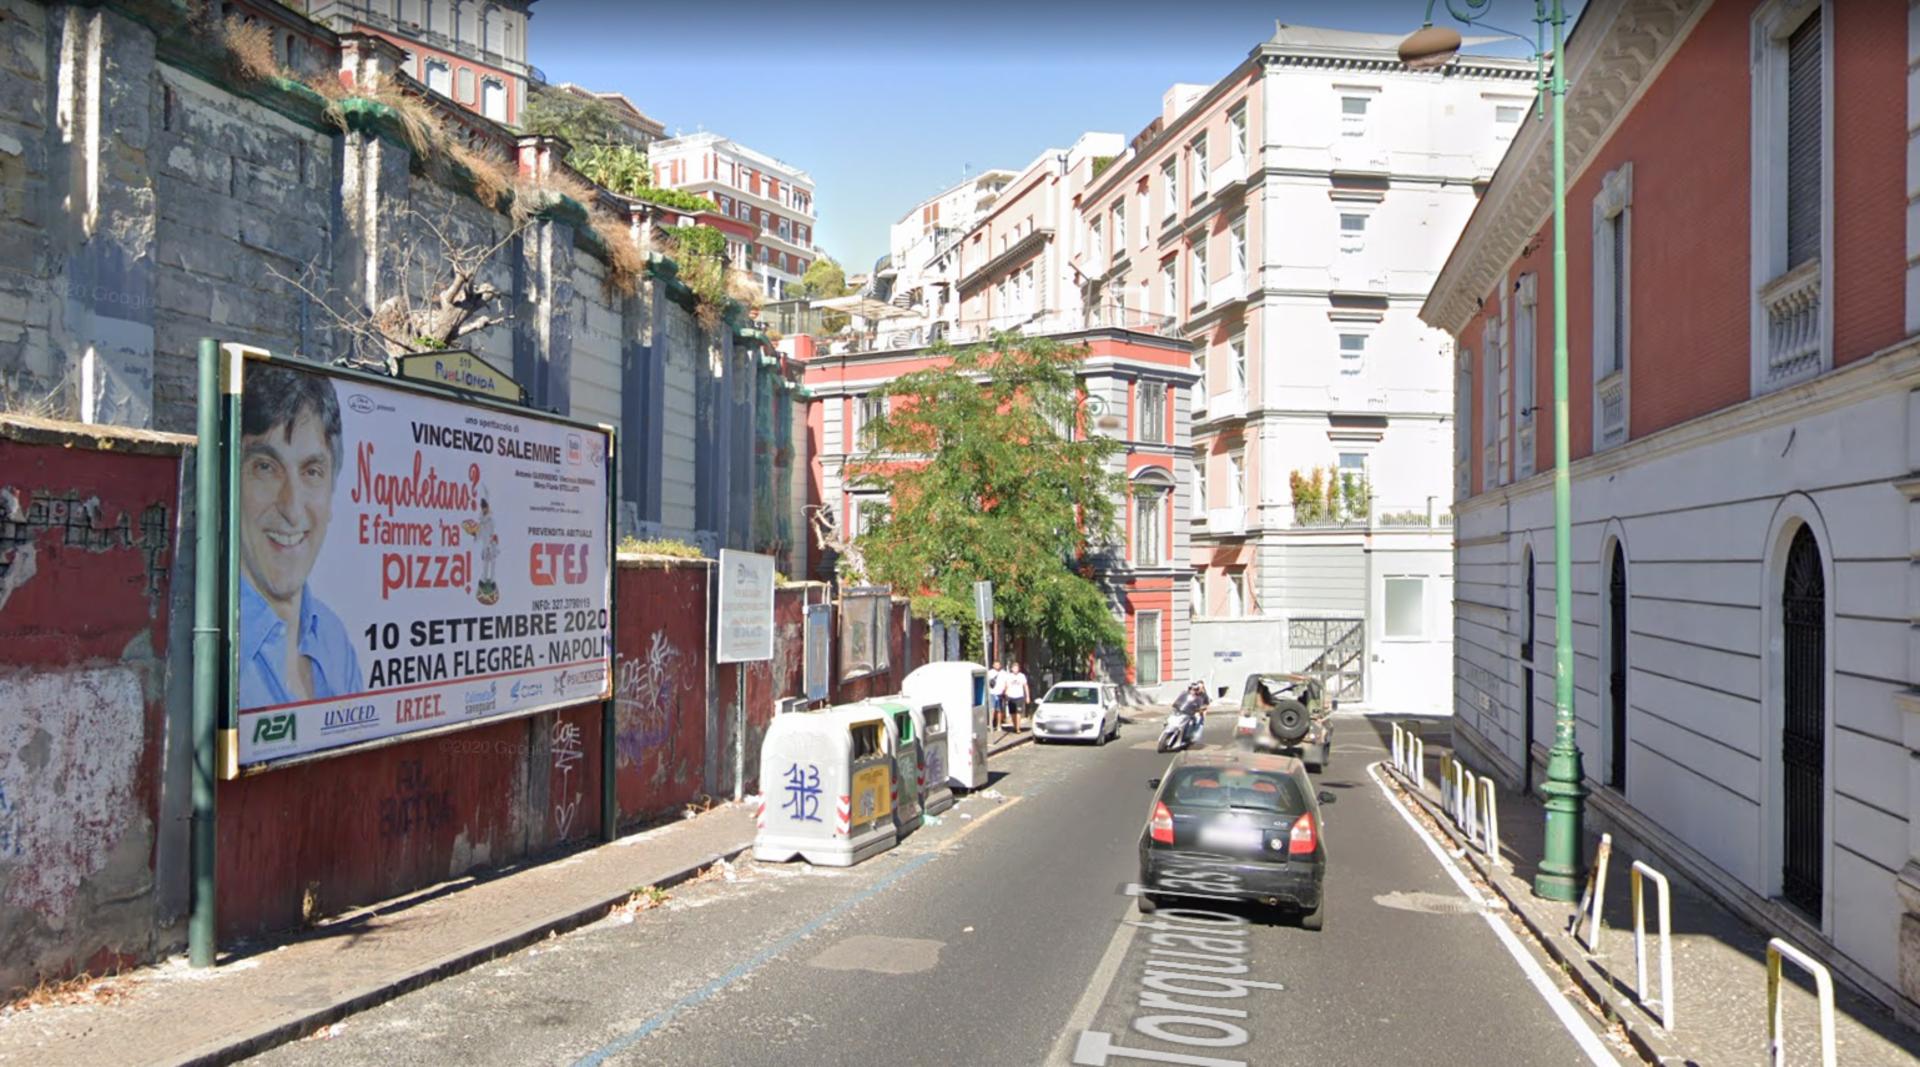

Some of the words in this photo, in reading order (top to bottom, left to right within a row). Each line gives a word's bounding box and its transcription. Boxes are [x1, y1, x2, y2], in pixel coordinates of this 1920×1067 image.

[411, 421, 494, 454] VINCENZO
[497, 436, 561, 465] SALEMME
[351, 440, 480, 516] Napoletano?
[359, 513, 369, 544] E
[372, 516, 432, 547] famme
[381, 551, 472, 600] pizza!
[529, 543, 590, 586] ETES
[365, 622, 400, 650] 10
[410, 613, 557, 647] SETTEMBRE
[563, 608, 607, 632] 2020
[368, 652, 447, 688] ARENA
[454, 644, 535, 677] FLEGREA
[549, 635, 605, 664] NAPOLI
